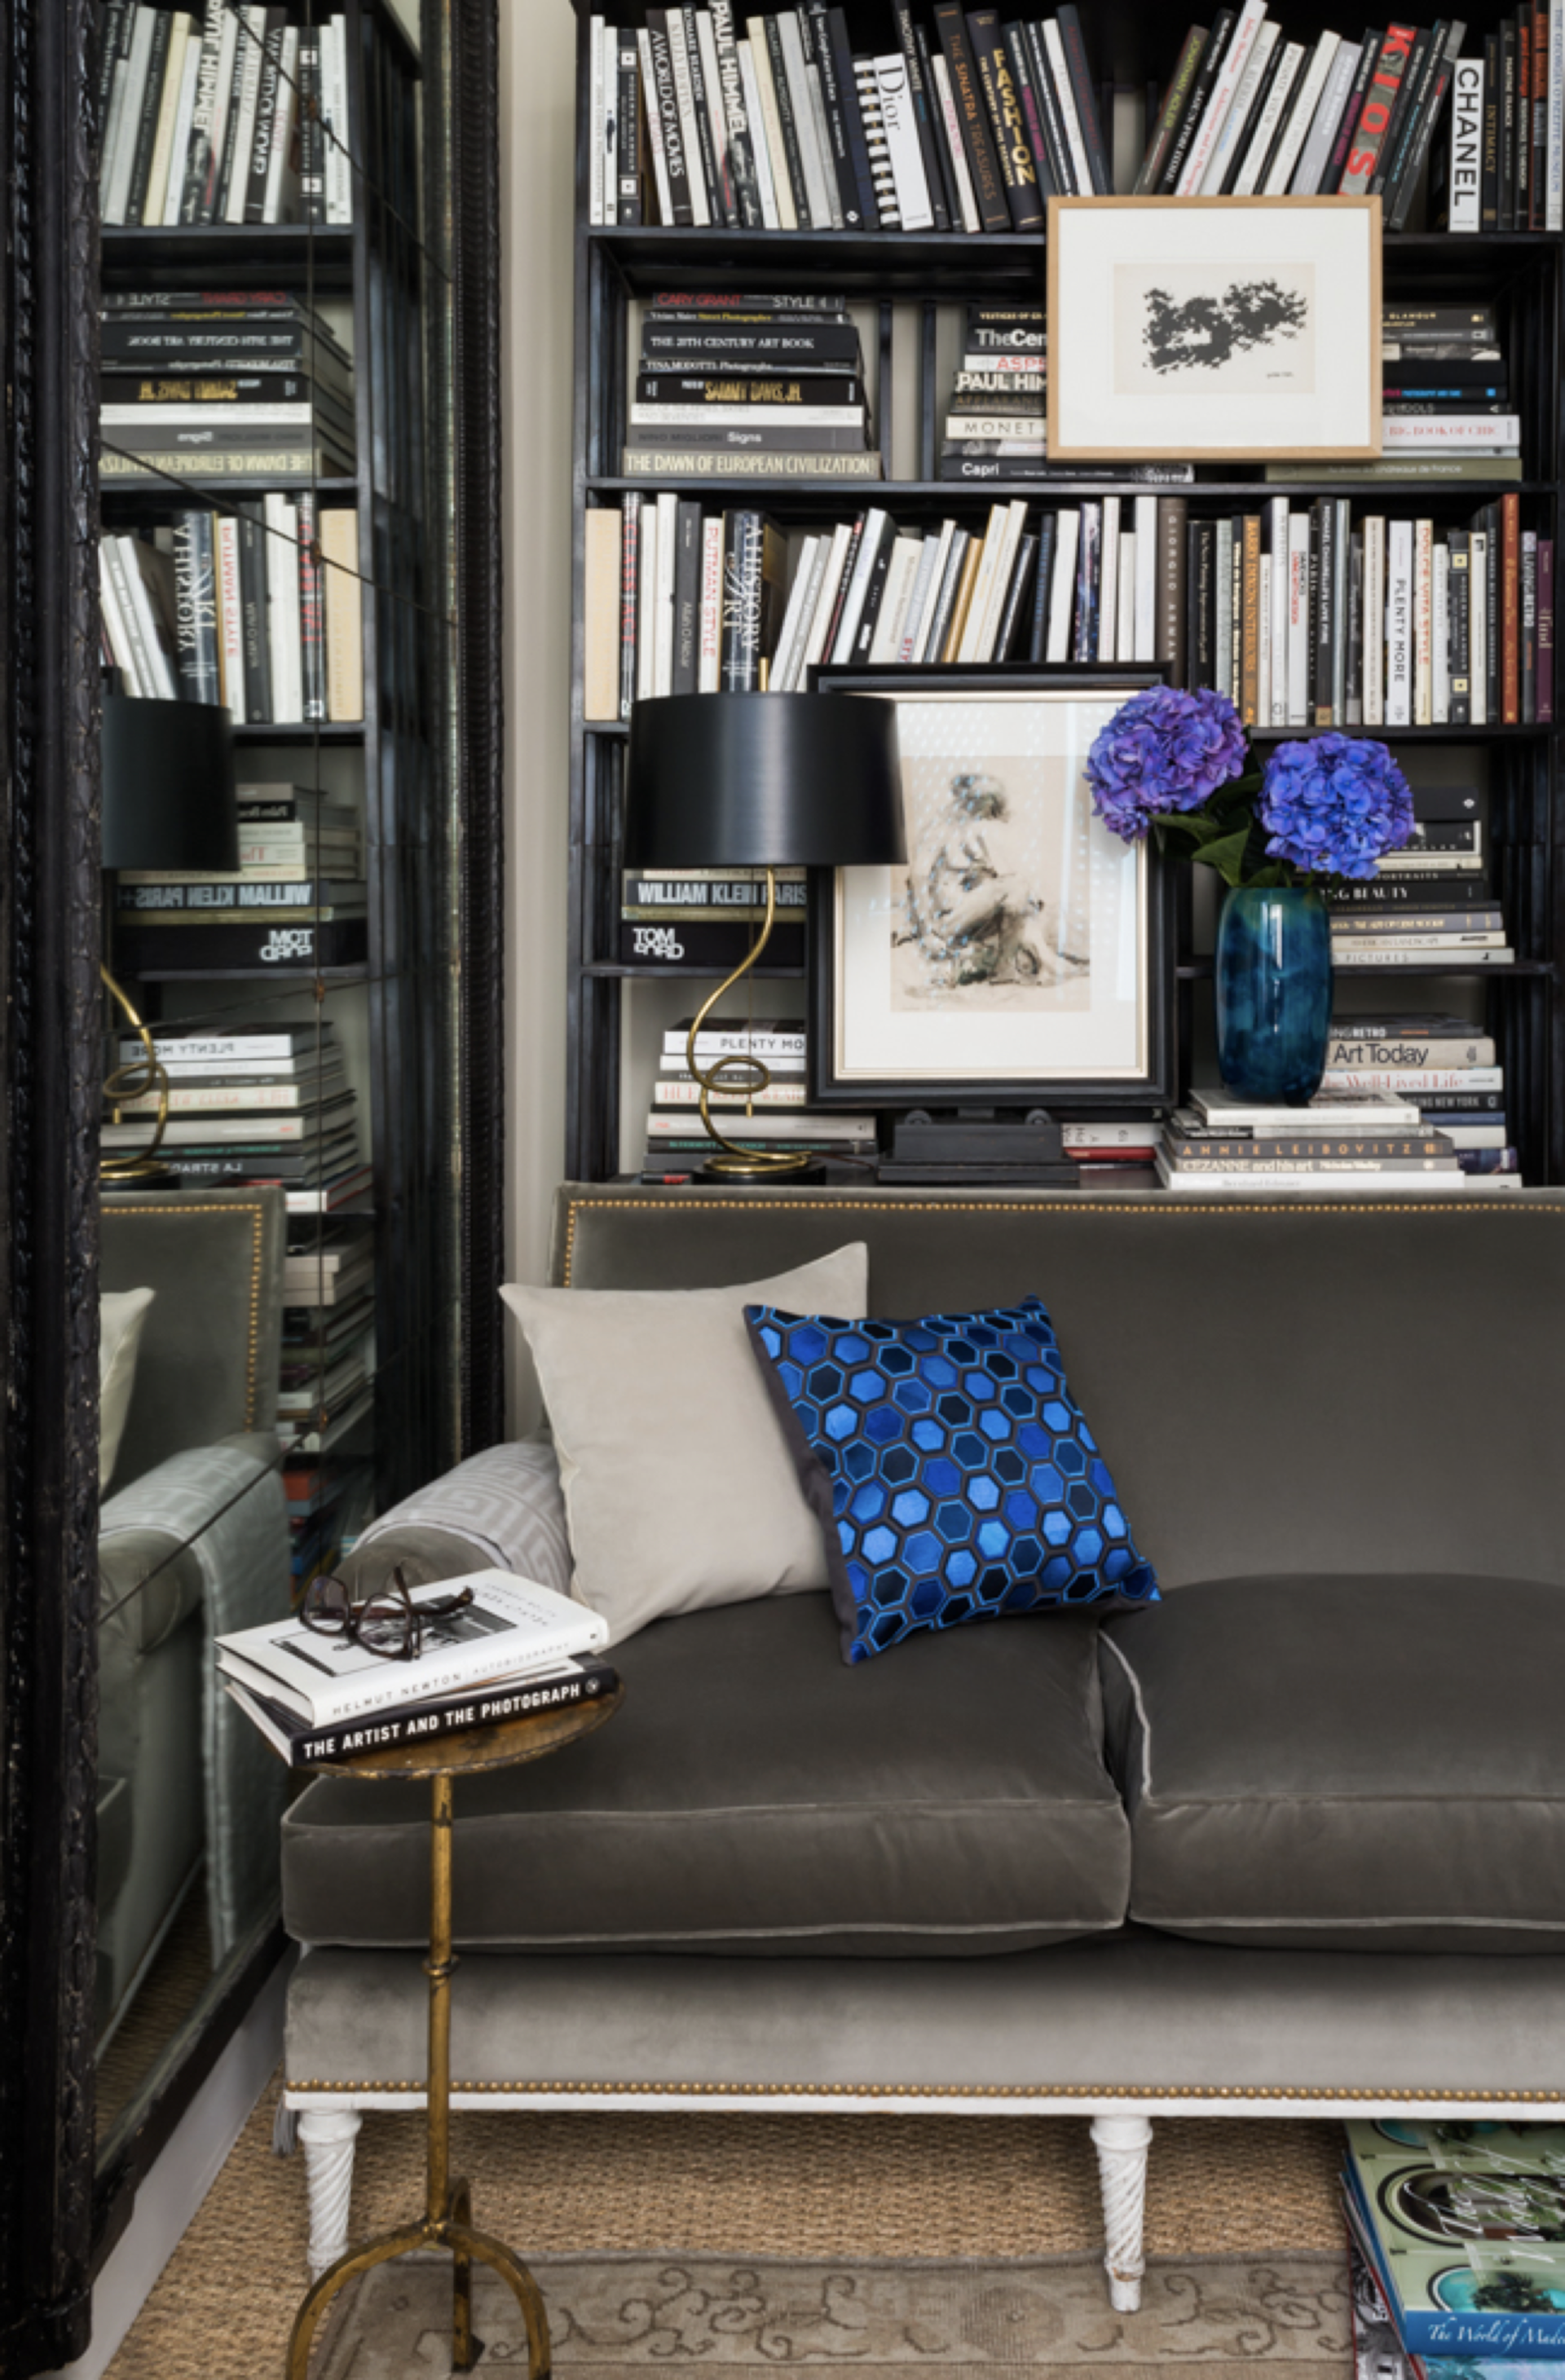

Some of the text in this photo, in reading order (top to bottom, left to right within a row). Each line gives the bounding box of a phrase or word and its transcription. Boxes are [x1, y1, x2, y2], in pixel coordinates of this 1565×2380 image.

[711, 2, 746, 135] PAUL HIMMEL
[1162, 34, 1202, 130] JONATHAN ADLER
[652, 40, 672, 98] WORLD
[665, 121, 685, 178] MOVIES
[876, 66, 906, 130] Dior
[993, 48, 1036, 186] FASHION
[1338, 34, 1414, 196] KIOS
[954, 60, 979, 121] SINATRA
[968, 121, 998, 201] TREASURES
[1453, 67, 1479, 207] CHANEL
[1484, 104, 1497, 174] INTIMACY
[1549, 144, 1560, 192] MUSEUM
[657, 293, 742, 306] CARY GRANT
[773, 297, 814, 308] STYLE
[650, 336, 673, 347] THE
[703, 337, 755, 348] CENTURY
[758, 337, 778, 348] ART
[781, 337, 815, 348] BOOK
[955, 372, 1009, 391] PAUL
[727, 432, 762, 444] Signs
[964, 421, 1036, 434] MONET
[627, 454, 872, 475] THE DAWN OF EUROPEAN CIVILIZATION
[962, 463, 999, 477] Capri
[1320, 505, 1331, 544] MICHAEL
[1167, 515, 1178, 591] GIORGIO
[622, 524, 637, 645] CLASS ACT
[702, 526, 719, 658] PUTMAN STYLE
[740, 545, 762, 651] HISTORY
[1245, 562, 1257, 606] DIXON
[1319, 602, 1329, 622] LIVE
[1393, 577, 1407, 683] PLENTY MORE
[1245, 606, 1257, 672] INTERIORS
[1319, 623, 1329, 645] FIRE
[637, 882, 707, 905] WILLIAM
[712, 883, 757, 905] KLEIN
[633, 928, 676, 945] TOM
[633, 941, 685, 959] FORD
[720, 1038, 775, 1050] PLENTY
[1333, 1043, 1429, 1067] Art Today
[1432, 1073, 1463, 1088] Life
[1183, 1144, 1412, 1156] ANNIE LEIBOVITZ
[1252, 1160, 1275, 1171] and
[1296, 1160, 1313, 1171] art
[333, 1690, 394, 1717] HELMUT
[401, 1672, 463, 1696] NEWTON
[303, 1683, 580, 1759] THE ARTIST AND THE PHOTOGRAPH
[1428, 2316, 1457, 2341] The
[1457, 2320, 1510, 2343] World
